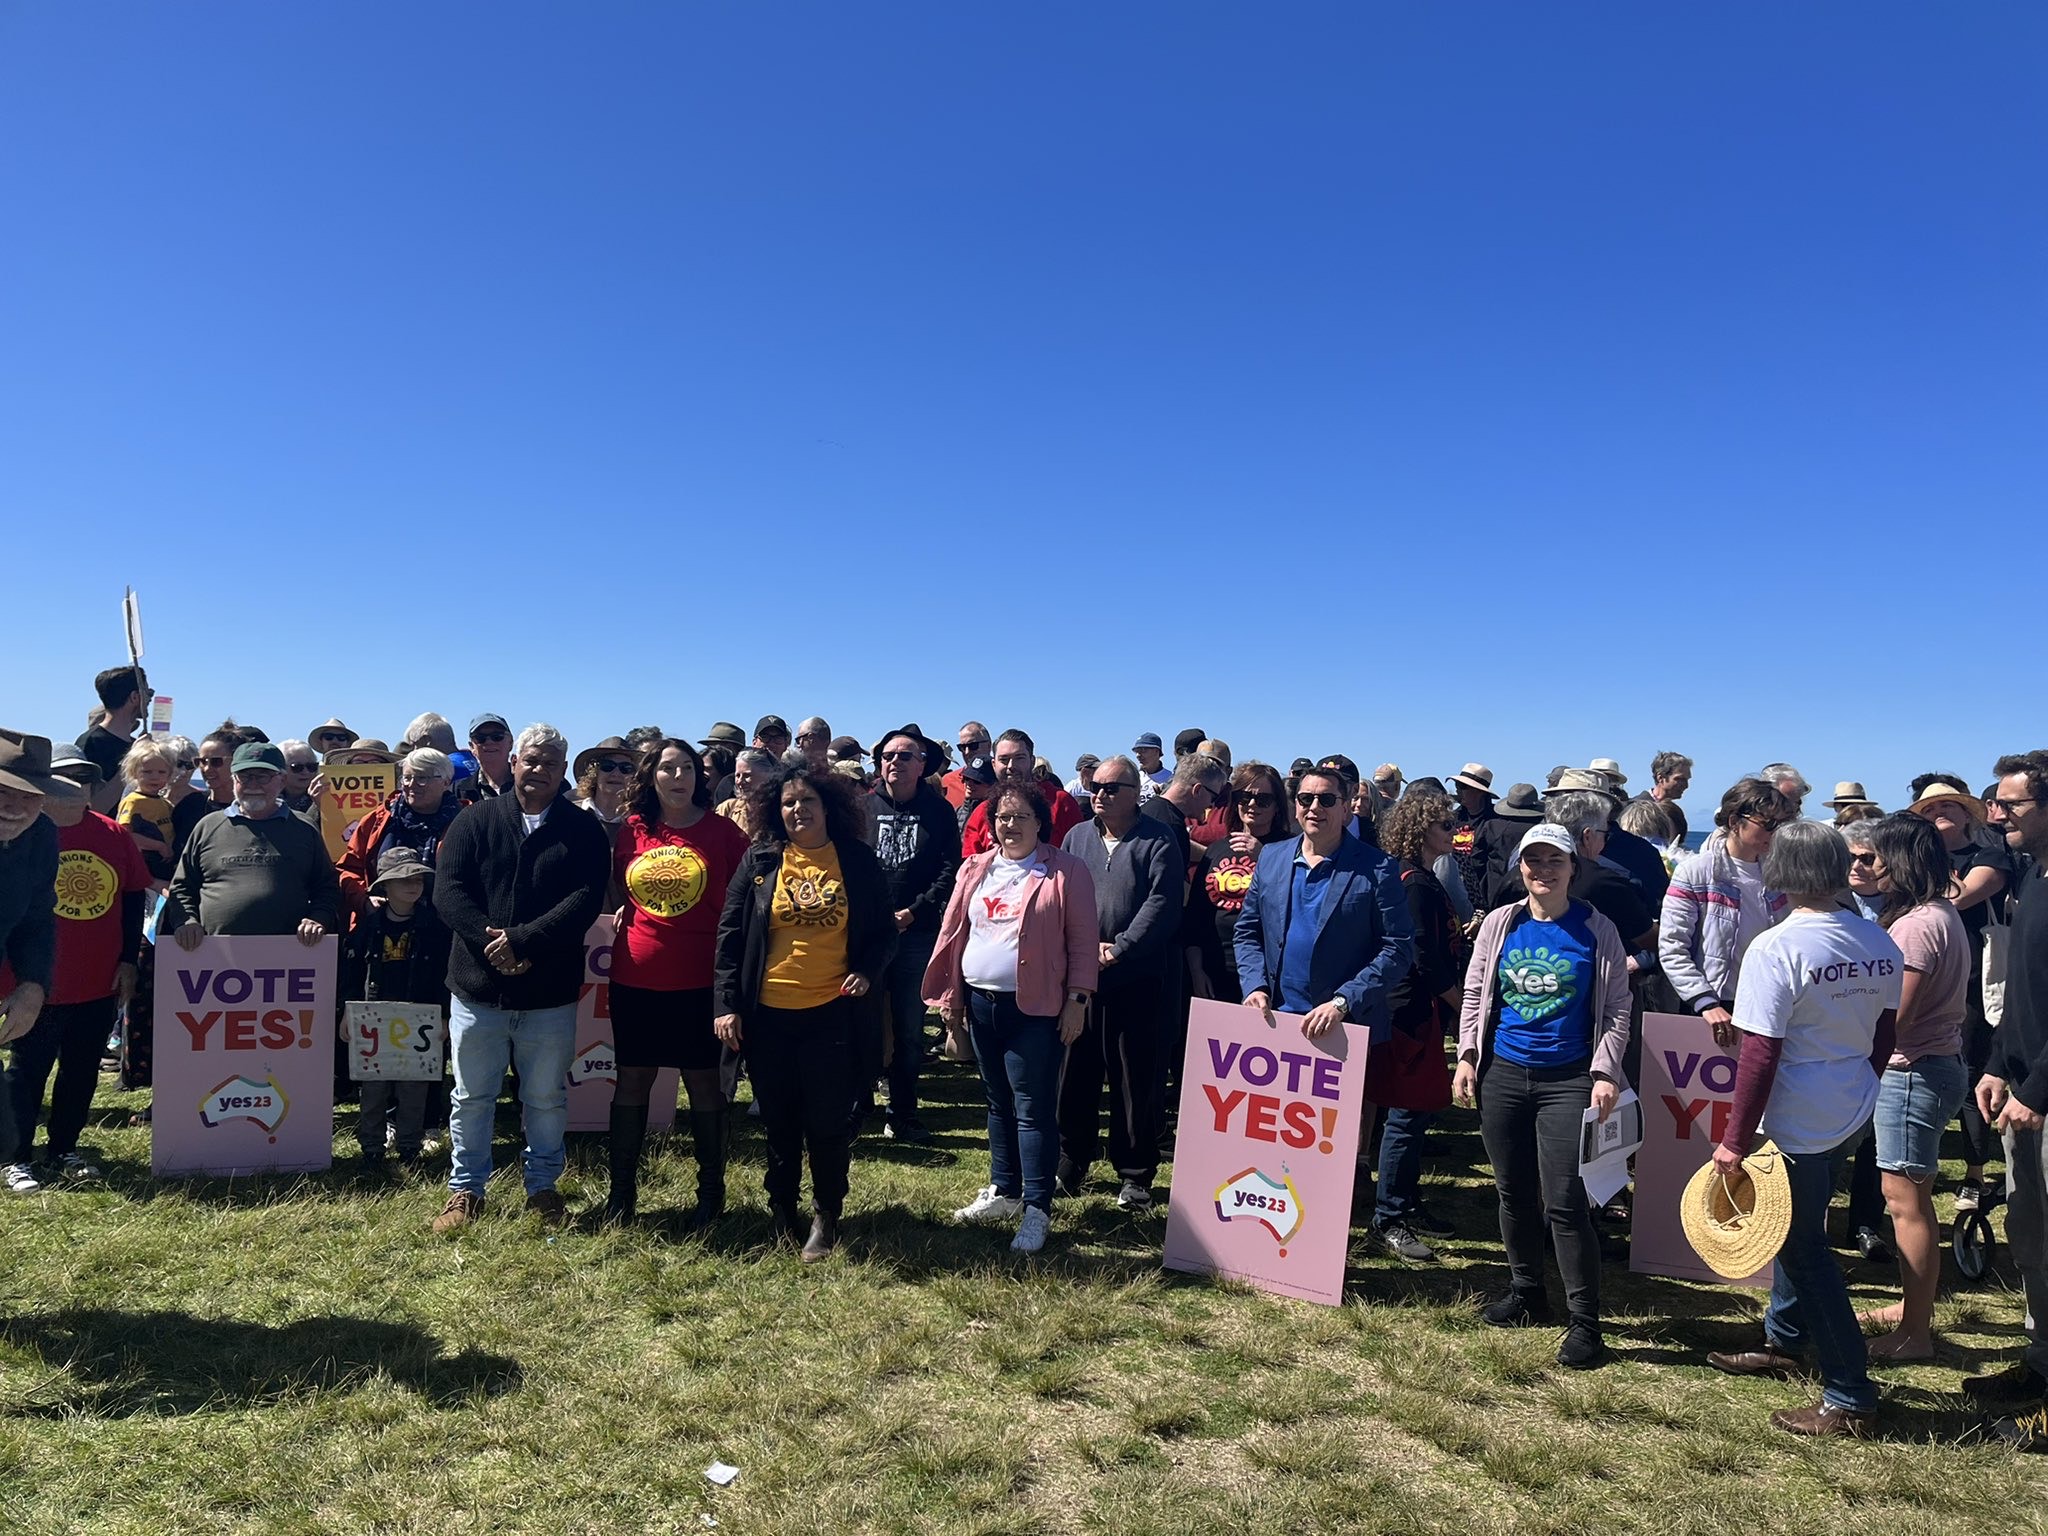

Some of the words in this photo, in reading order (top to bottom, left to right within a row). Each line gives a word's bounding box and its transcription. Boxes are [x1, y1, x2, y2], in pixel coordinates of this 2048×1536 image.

[331, 776, 384, 790] VOTE
[330, 792, 384, 809] YES!
[650, 848, 688, 860] UNIONS
[1214, 870, 1252, 892] Yes
[59, 904, 80, 916] FOR
[87, 903, 105, 915] YES
[644, 900, 664, 913] FOR
[669, 899, 688, 913] YES
[1505, 968, 1559, 995] Yes
[1808, 962, 1858, 985] VOTE
[1862, 959, 1894, 977] YES
[177, 969, 316, 1004] VOTE
[175, 1010, 314, 1051] YES!
[360, 1017, 434, 1057] yes
[583, 1059, 617, 1073] yes
[1208, 1038, 1343, 1101] VOTE
[1664, 1050, 1738, 1093] VO
[219, 1096, 272, 1112] yes23
[1202, 1084, 1338, 1154] YES!
[1234, 1190, 1286, 1213] yes23
